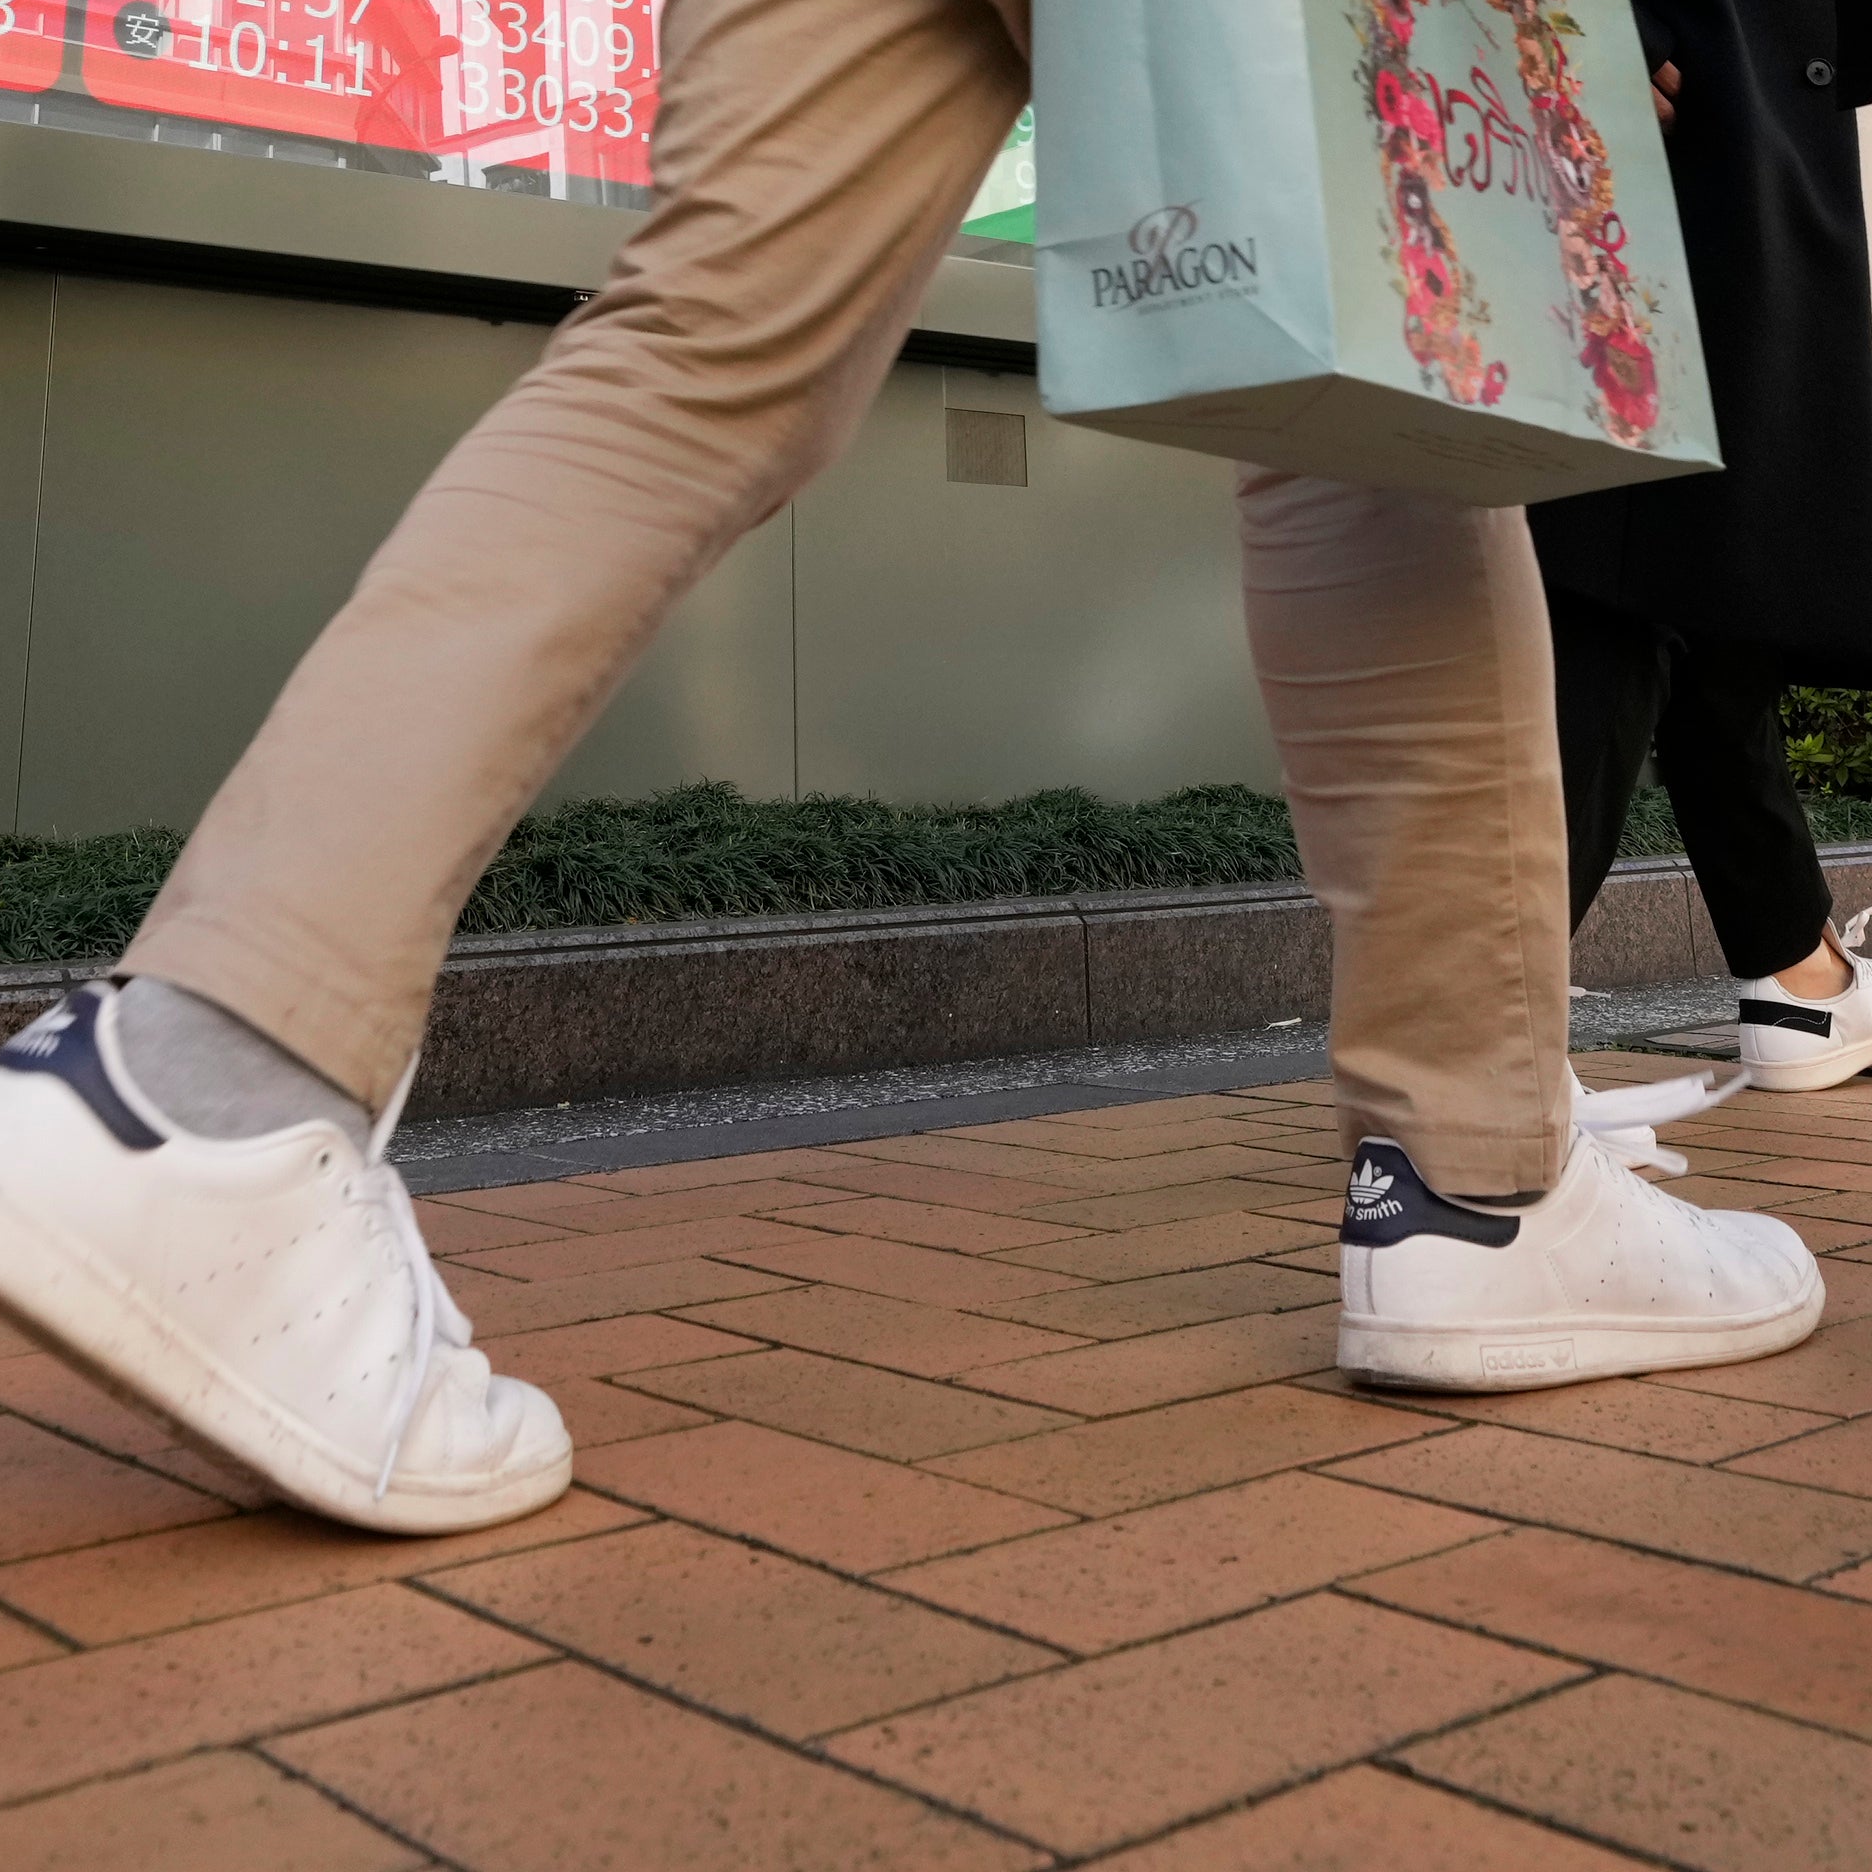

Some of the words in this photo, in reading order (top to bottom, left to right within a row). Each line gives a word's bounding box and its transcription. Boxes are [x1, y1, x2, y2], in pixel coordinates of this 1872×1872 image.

[124, 13, 163, 48] 安
[188, 13, 374, 97] 10:11
[1091, 237, 1259, 308] PARAGON
[1355, 1199, 1404, 1221] smith
